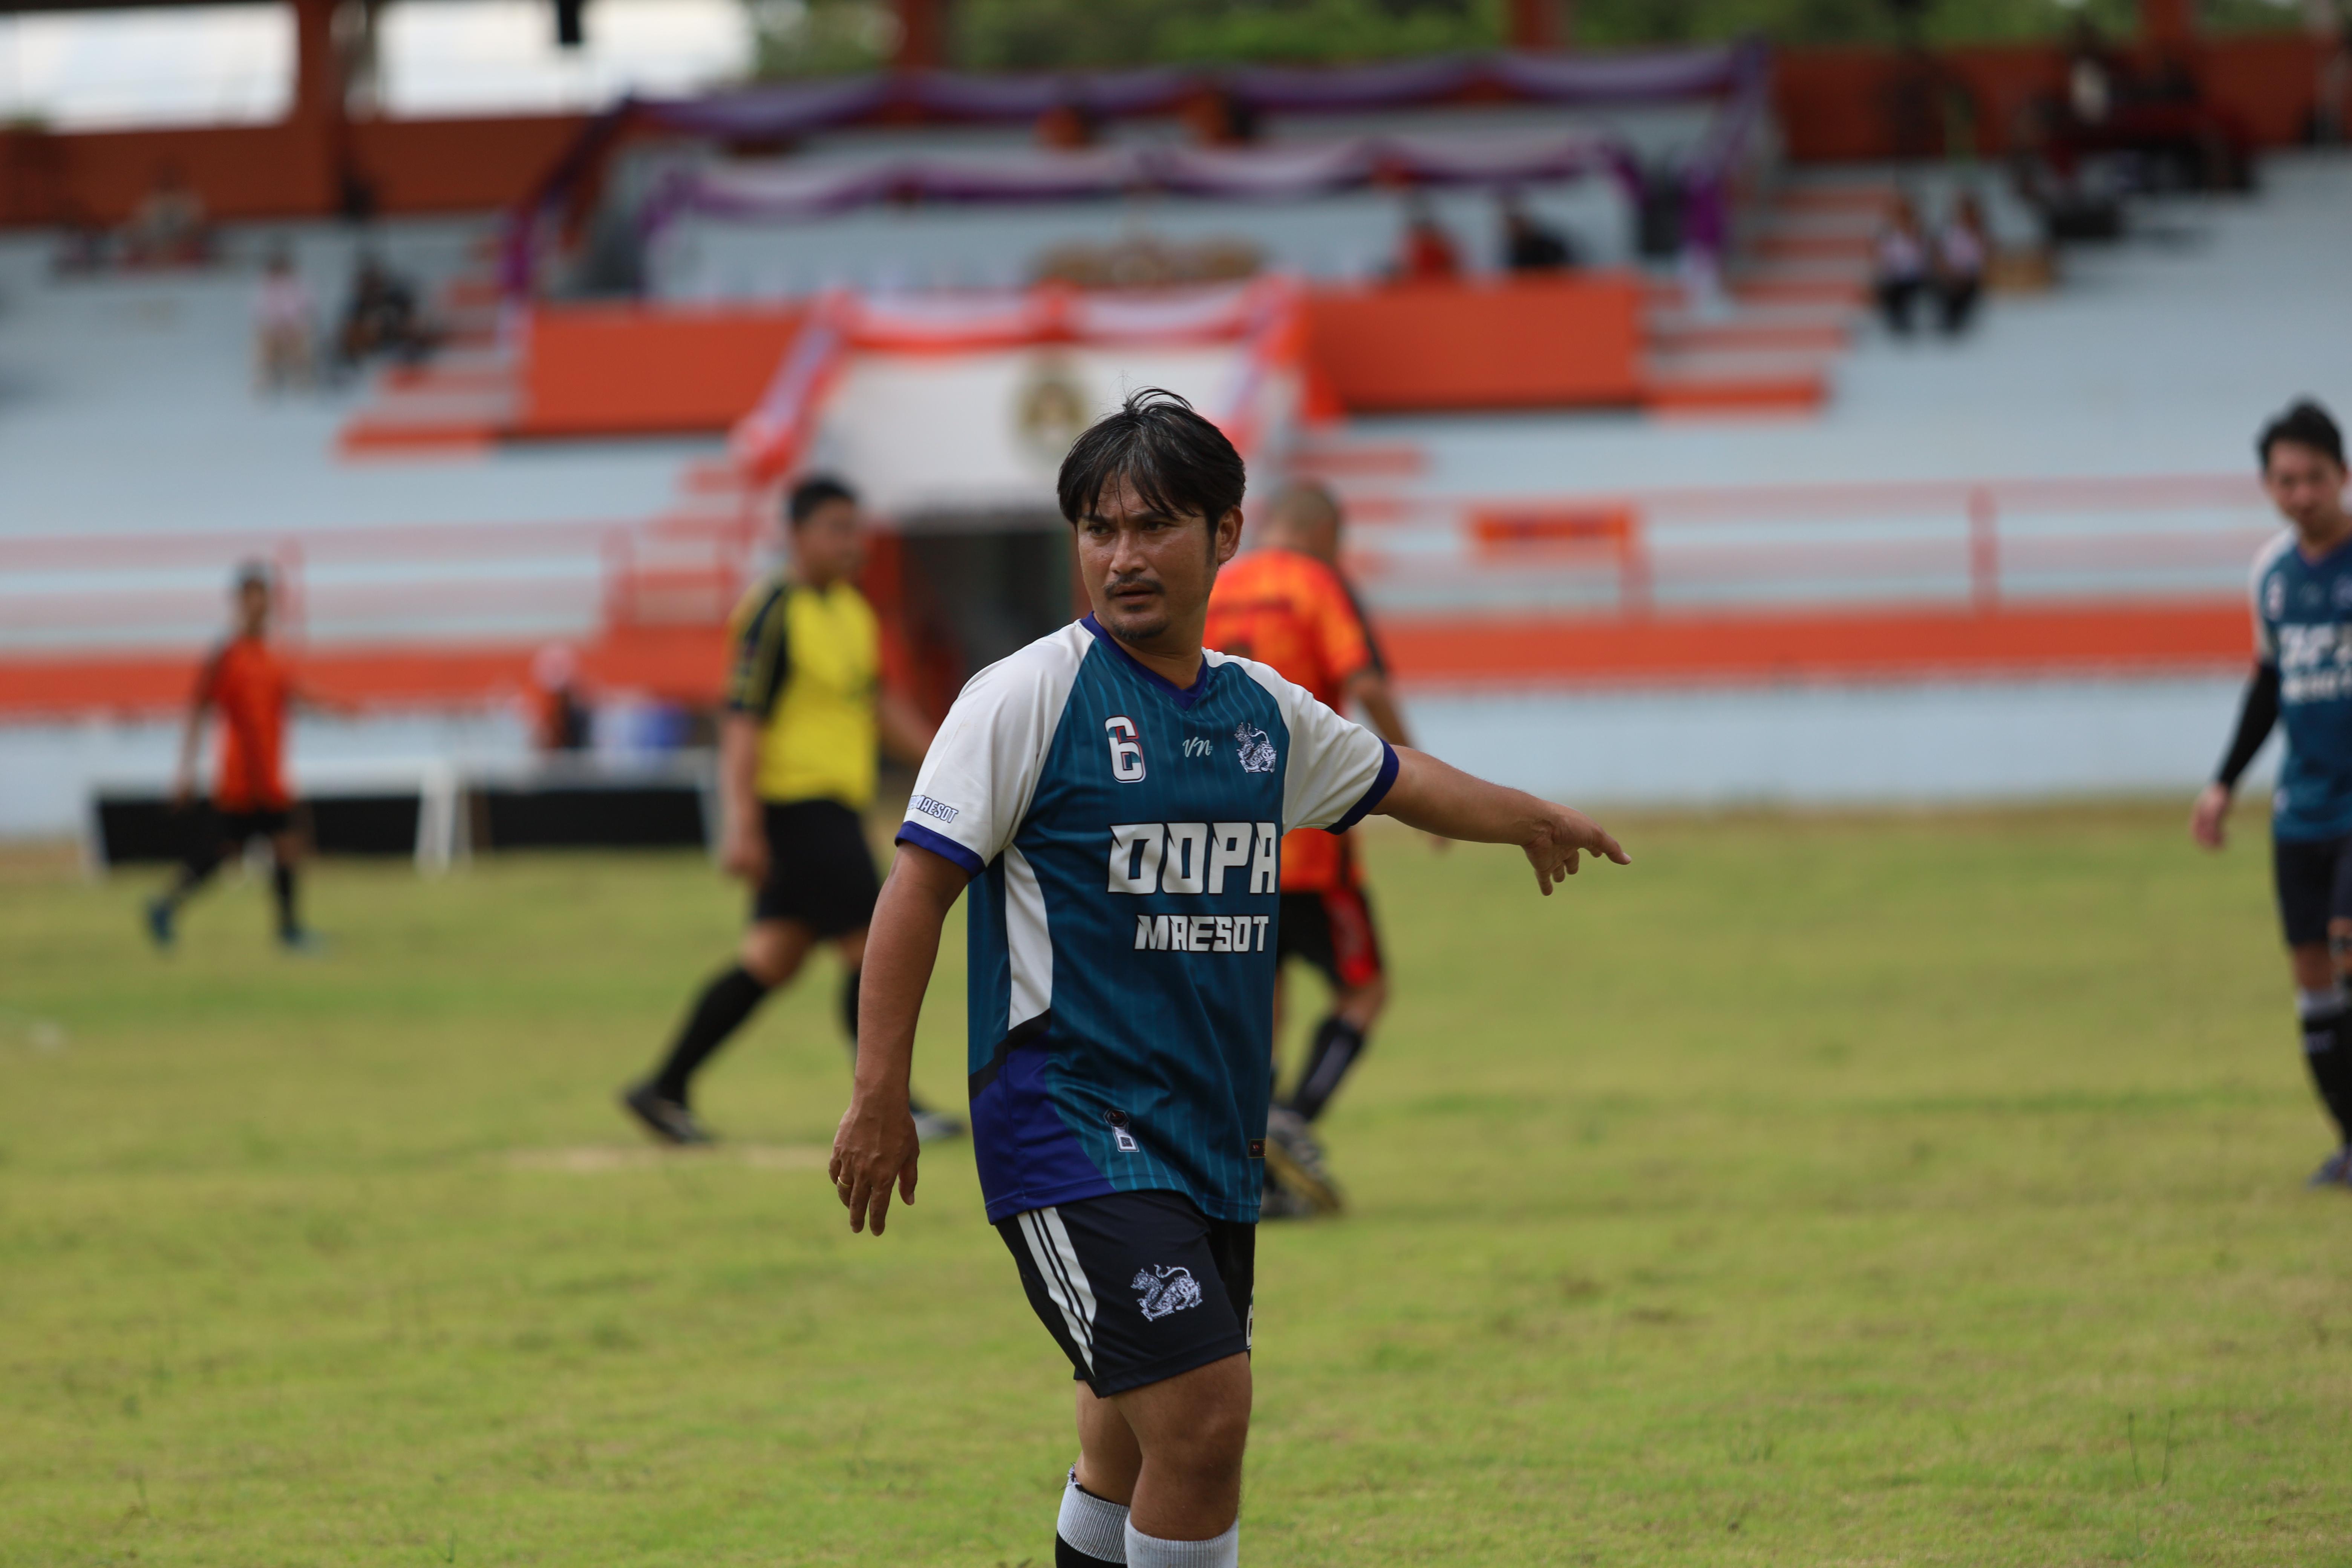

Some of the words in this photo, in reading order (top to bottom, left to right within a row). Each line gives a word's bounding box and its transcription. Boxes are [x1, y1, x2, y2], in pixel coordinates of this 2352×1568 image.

[1105, 715, 1146, 783] 6
[1107, 821, 1277, 894] DOPA
[1133, 914, 1269, 952] MAESOT
